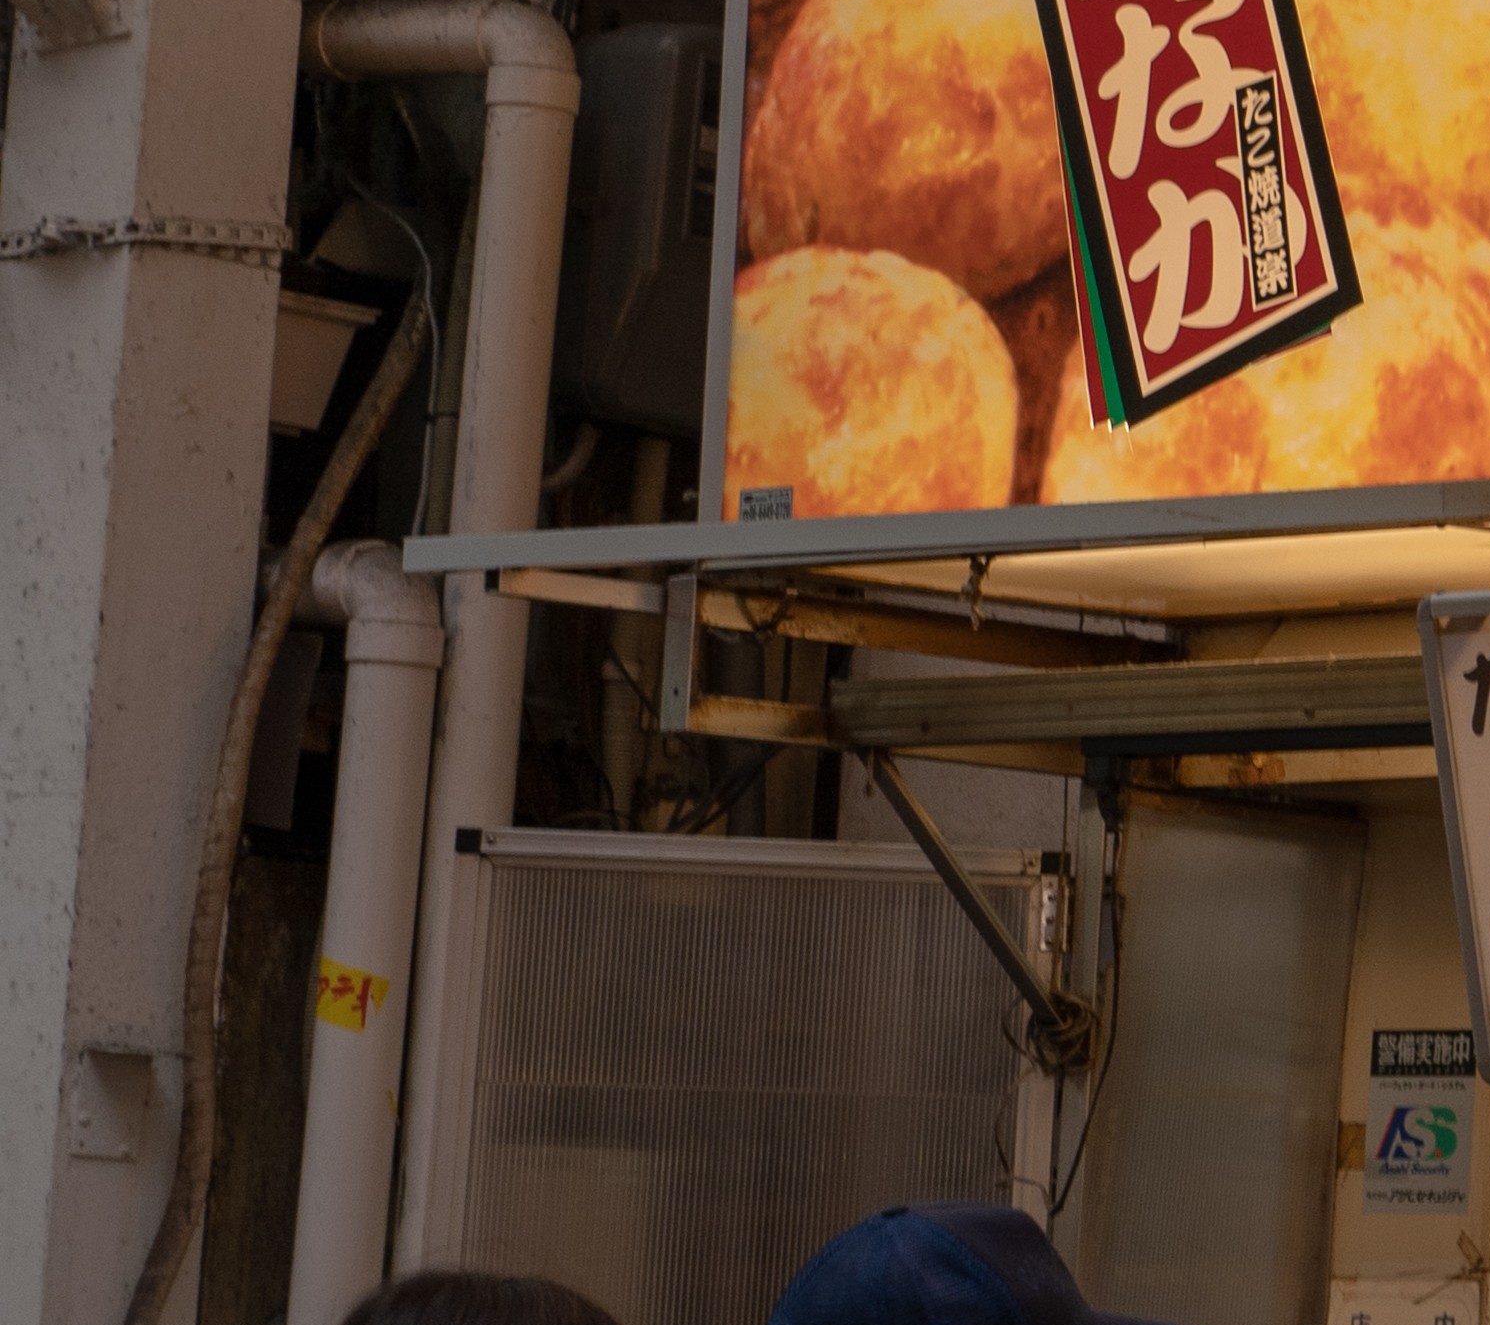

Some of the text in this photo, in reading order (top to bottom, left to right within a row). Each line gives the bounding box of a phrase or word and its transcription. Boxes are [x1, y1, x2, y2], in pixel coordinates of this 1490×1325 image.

[1239, 87, 1293, 300] たこ焼道楽
[1377, 1032, 1471, 1066] 警備実施中
